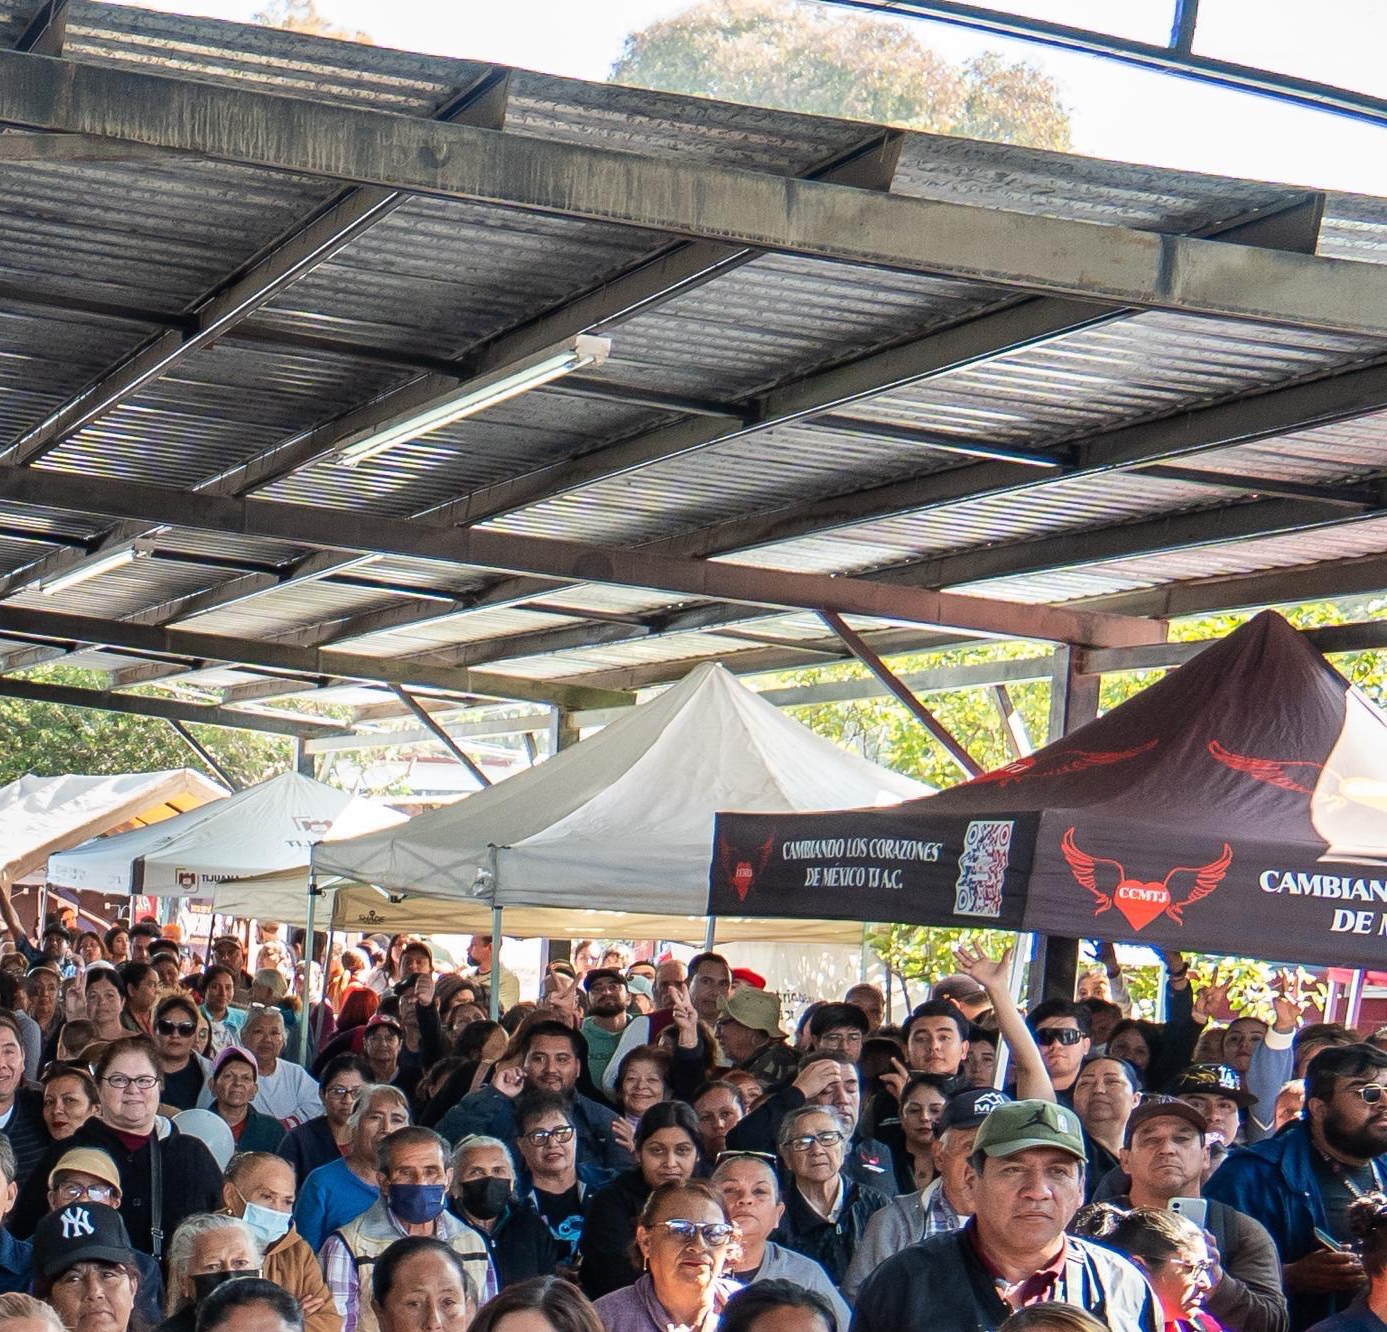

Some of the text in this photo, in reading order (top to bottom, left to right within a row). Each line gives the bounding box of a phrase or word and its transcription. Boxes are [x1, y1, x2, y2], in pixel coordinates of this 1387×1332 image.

[782, 838, 943, 862] CAMBIANDO LOS CORAZONES
[805, 867, 821, 887] DE
[821, 862, 865, 887] MÉXICO
[1118, 886, 1167, 904] CCMTJ
[1329, 908, 1375, 935] DE
